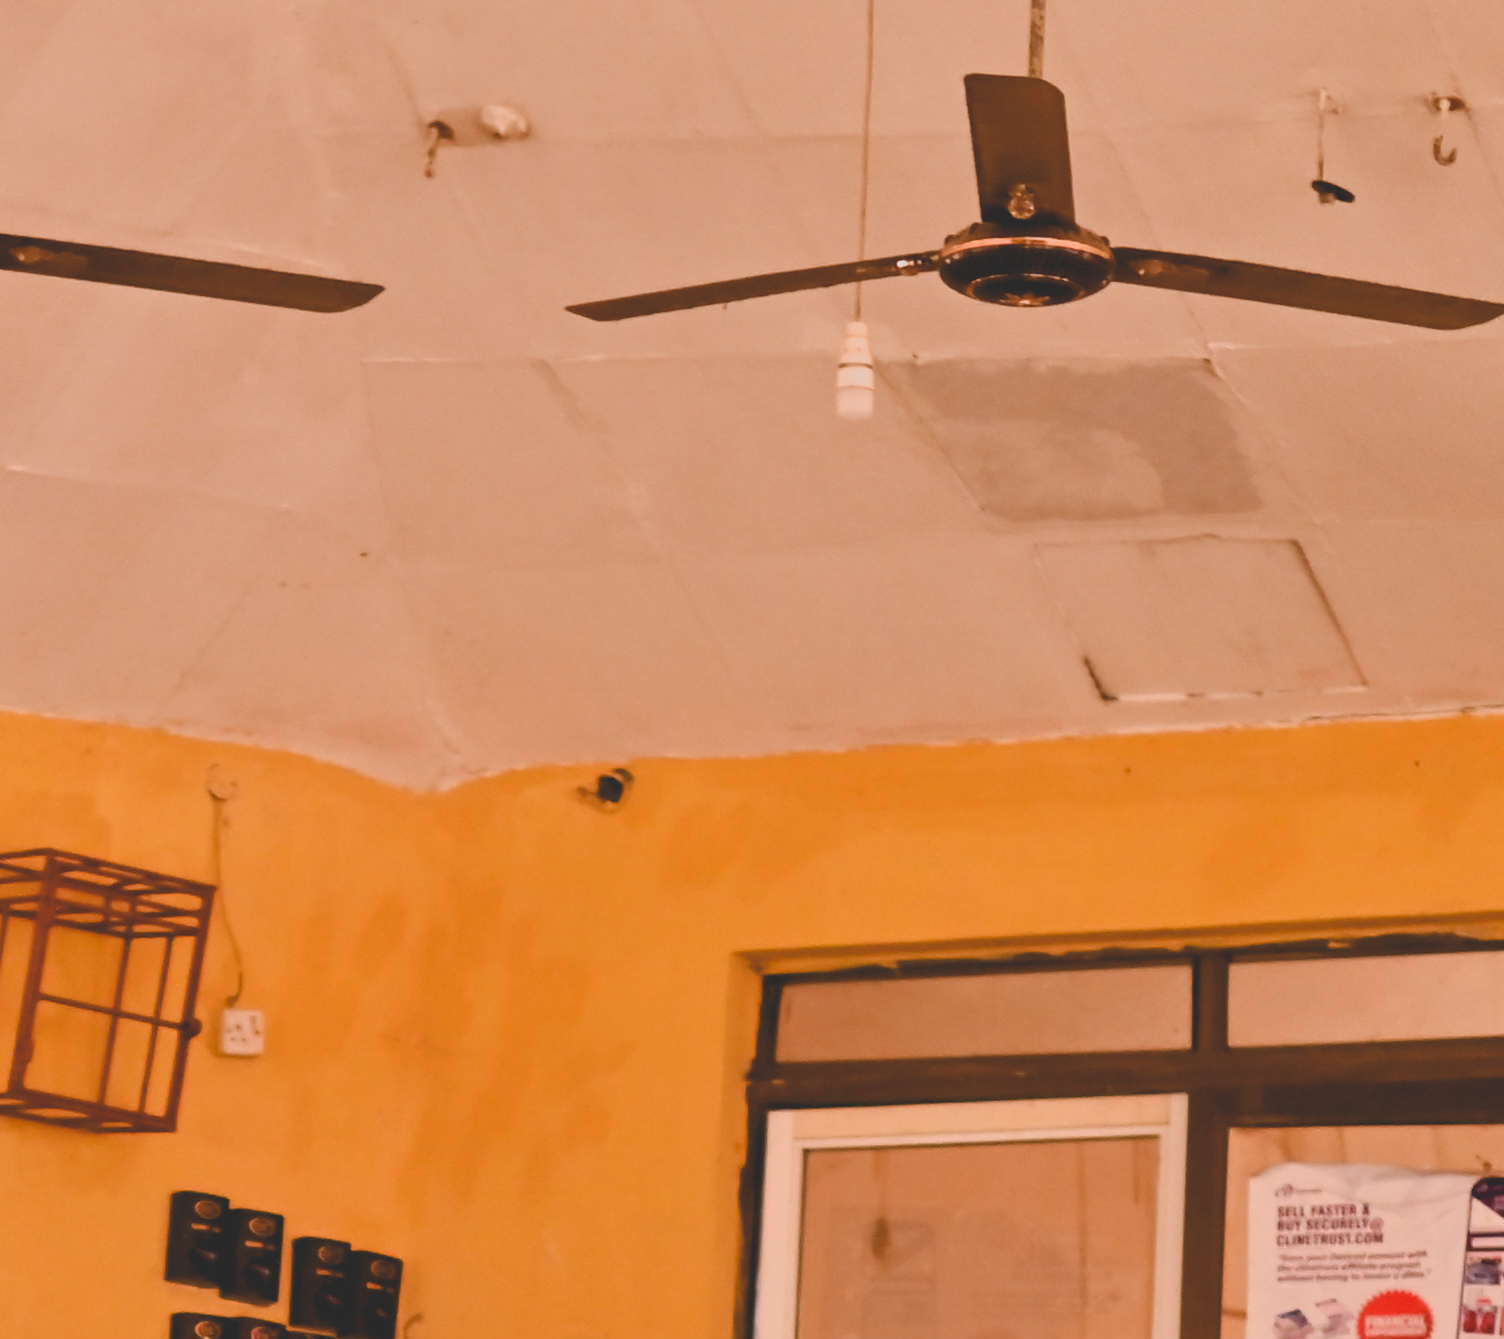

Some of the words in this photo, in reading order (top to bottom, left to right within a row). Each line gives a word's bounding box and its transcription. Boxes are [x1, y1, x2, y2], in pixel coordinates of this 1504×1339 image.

[1277, 1206, 1304, 1217] SELL
[1311, 1203, 1357, 1215] FASTER
[1277, 1219, 1301, 1231] BUY
